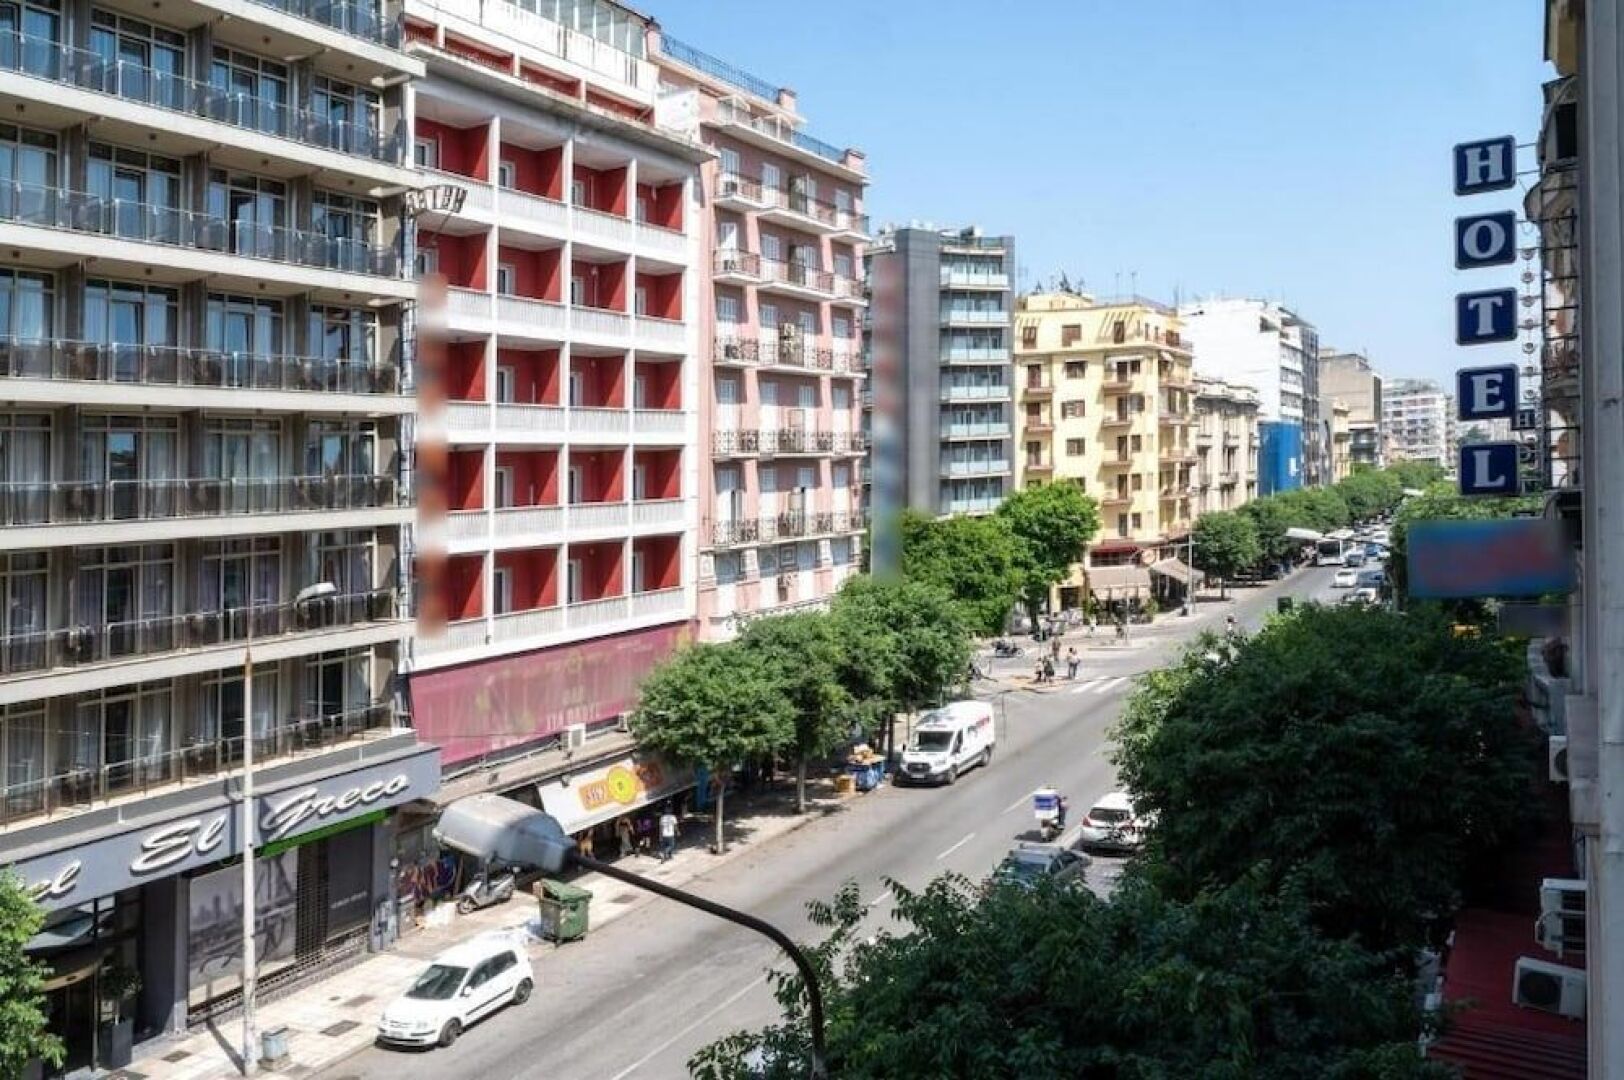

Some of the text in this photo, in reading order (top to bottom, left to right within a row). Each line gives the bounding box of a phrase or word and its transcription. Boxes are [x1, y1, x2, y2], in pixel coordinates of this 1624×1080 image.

[1463, 143, 1506, 488] HOTEL
[130, 813, 228, 874] El
[260, 773, 409, 842] Greco
